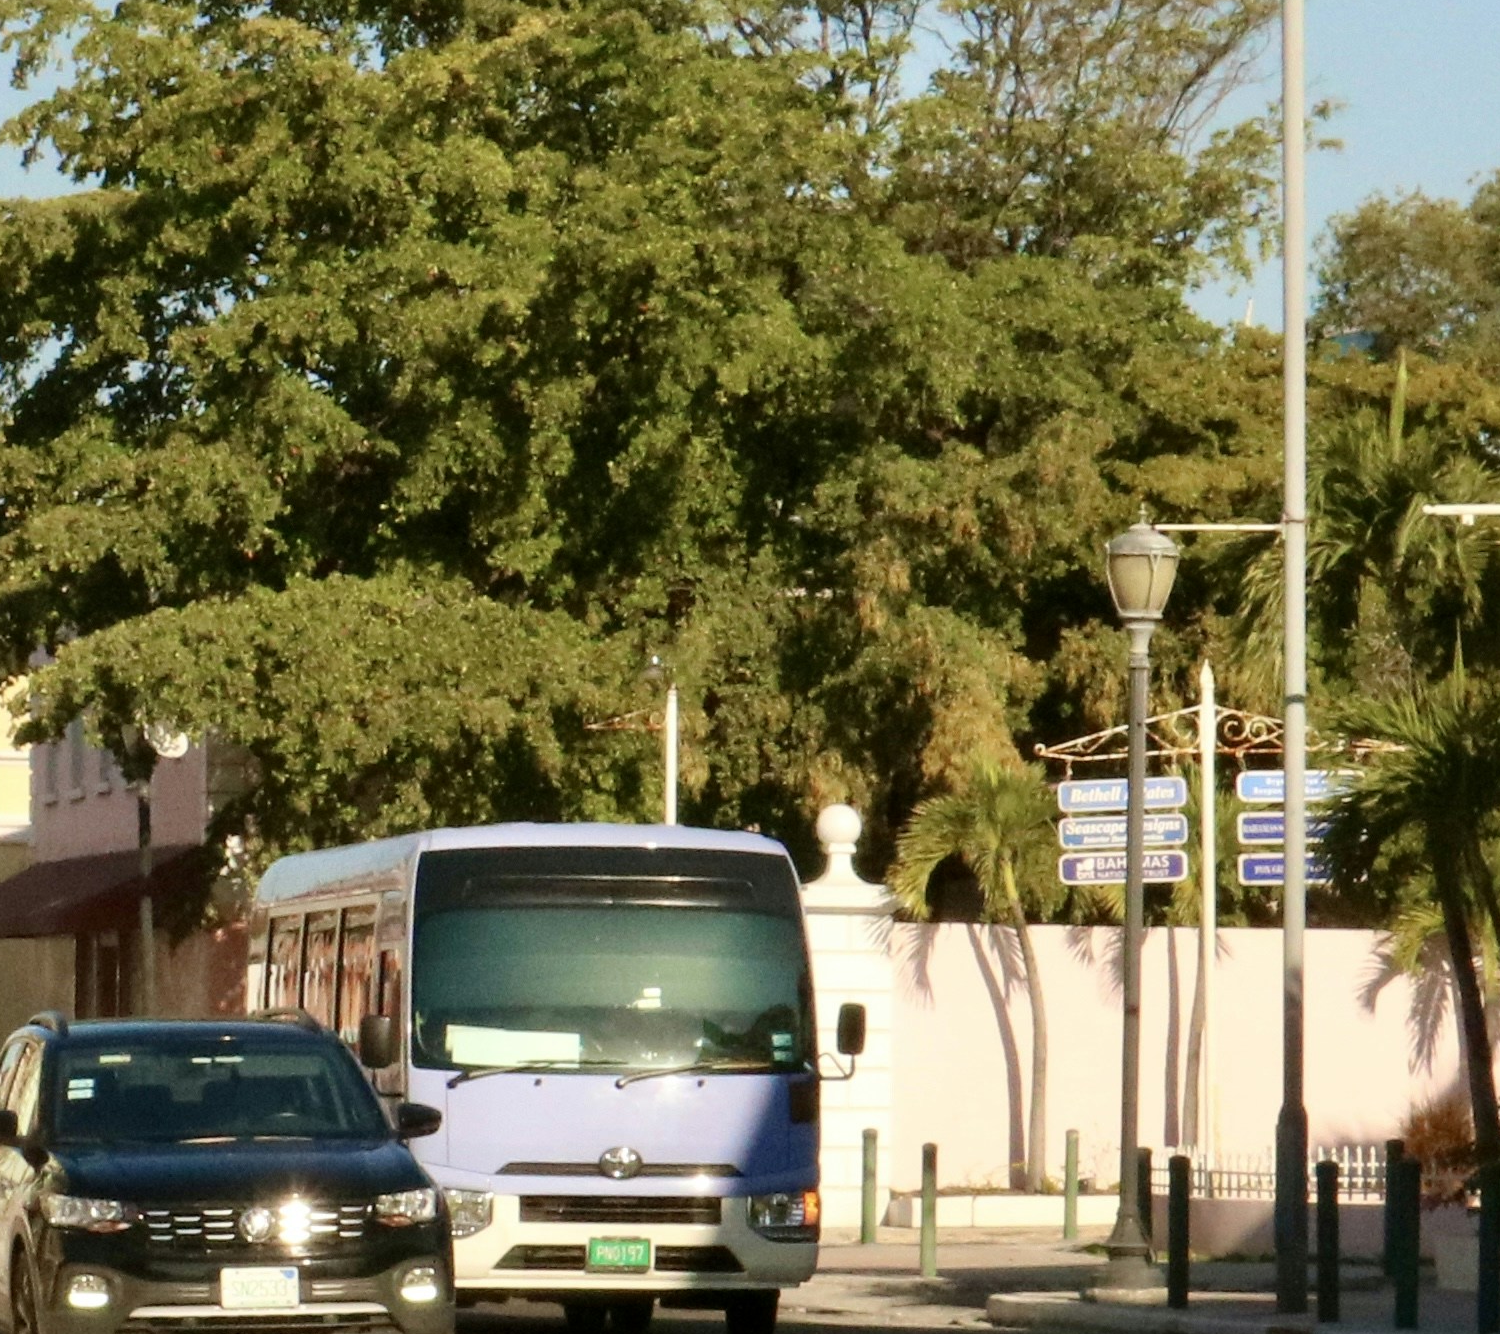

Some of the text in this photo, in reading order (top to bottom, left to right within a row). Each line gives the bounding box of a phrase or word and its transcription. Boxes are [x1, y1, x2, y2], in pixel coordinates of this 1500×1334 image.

[1071, 786, 1121, 802] Bethell
[1065, 821, 1127, 836] Seascape
[1098, 856, 1169, 869] BAHMAS
[1143, 869, 1169, 877] TRUST
[231, 1278, 288, 1297] SN2533
